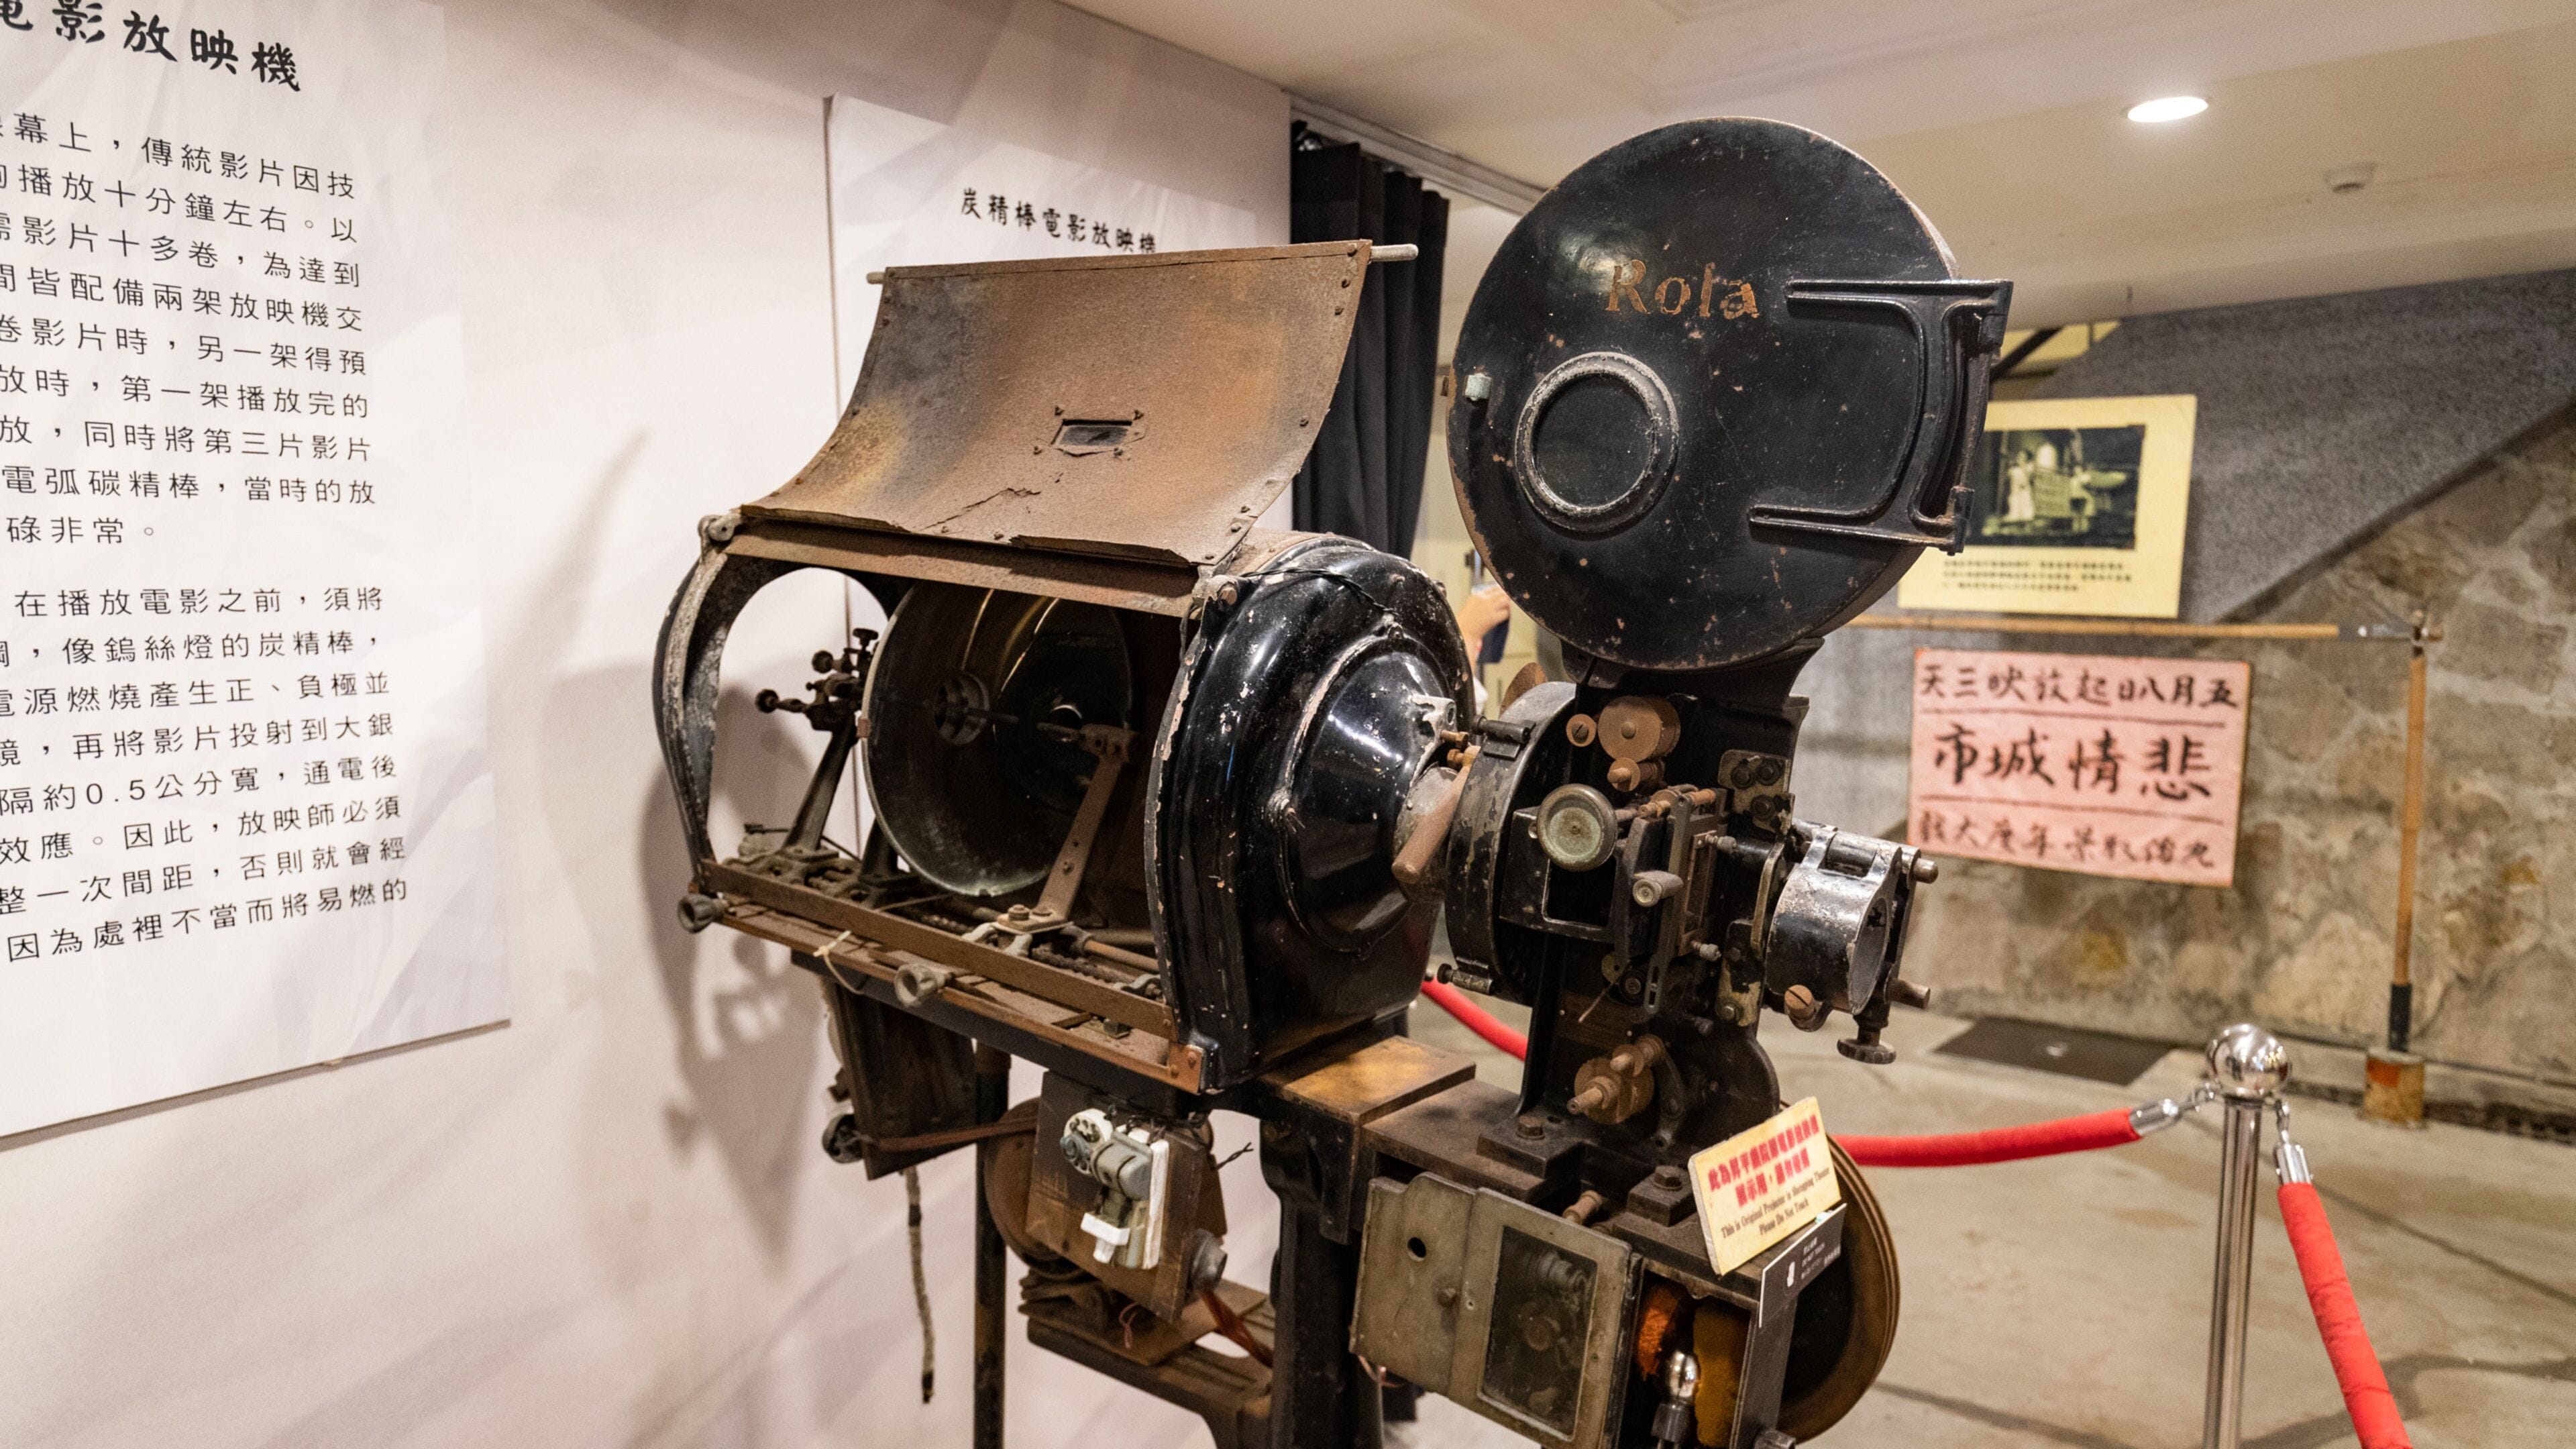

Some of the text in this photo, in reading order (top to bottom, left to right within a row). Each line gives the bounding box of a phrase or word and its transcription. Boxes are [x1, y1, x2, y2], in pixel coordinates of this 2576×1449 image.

[0, 113, 355, 199] 幕上，傳統影片因技
[0, 164, 358, 244] 播放十分鐘左右。以
[961, 188, 1156, 253] 炭精棒電影放映機
[2, 465, 376, 504] 電弧碳精棒，當時的放
[14, 586, 383, 618] 在播放電影之前，須將
[0, 630, 378, 668] ，像鎢絲燈的炭精棒，
[1721, 1224, 1735, 1238] This
